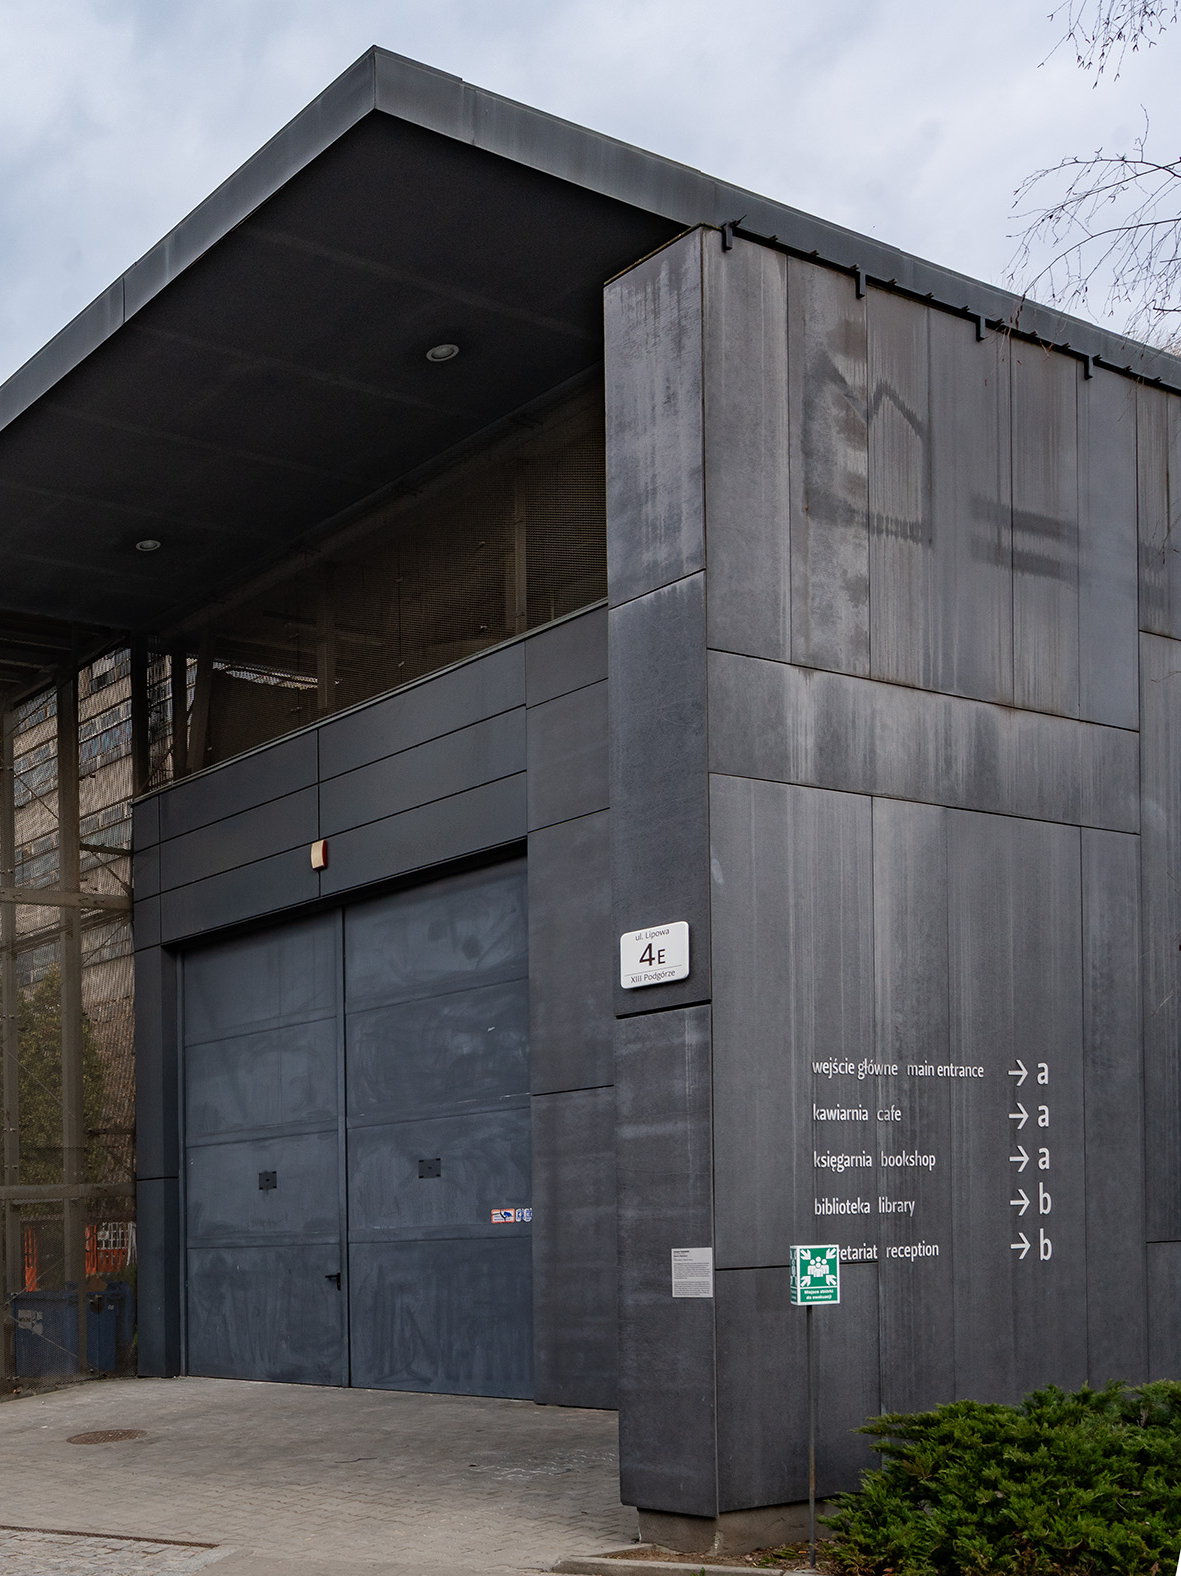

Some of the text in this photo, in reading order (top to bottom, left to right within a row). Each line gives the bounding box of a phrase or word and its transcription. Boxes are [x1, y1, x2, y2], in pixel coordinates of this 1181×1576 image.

[635, 928, 670, 941] ul. Lipowa
[630, 969, 676, 983] XIII Podgórze
[812, 1058, 1049, 1085] wejście główne main entrance a
[812, 1104, 1050, 1127] kawiarnia cafe a
[813, 1147, 1050, 1173] księgarnia bookshop a
[814, 1182, 1052, 1217] biblioteka library b
[838, 1228, 1053, 1262] etariat reception b
